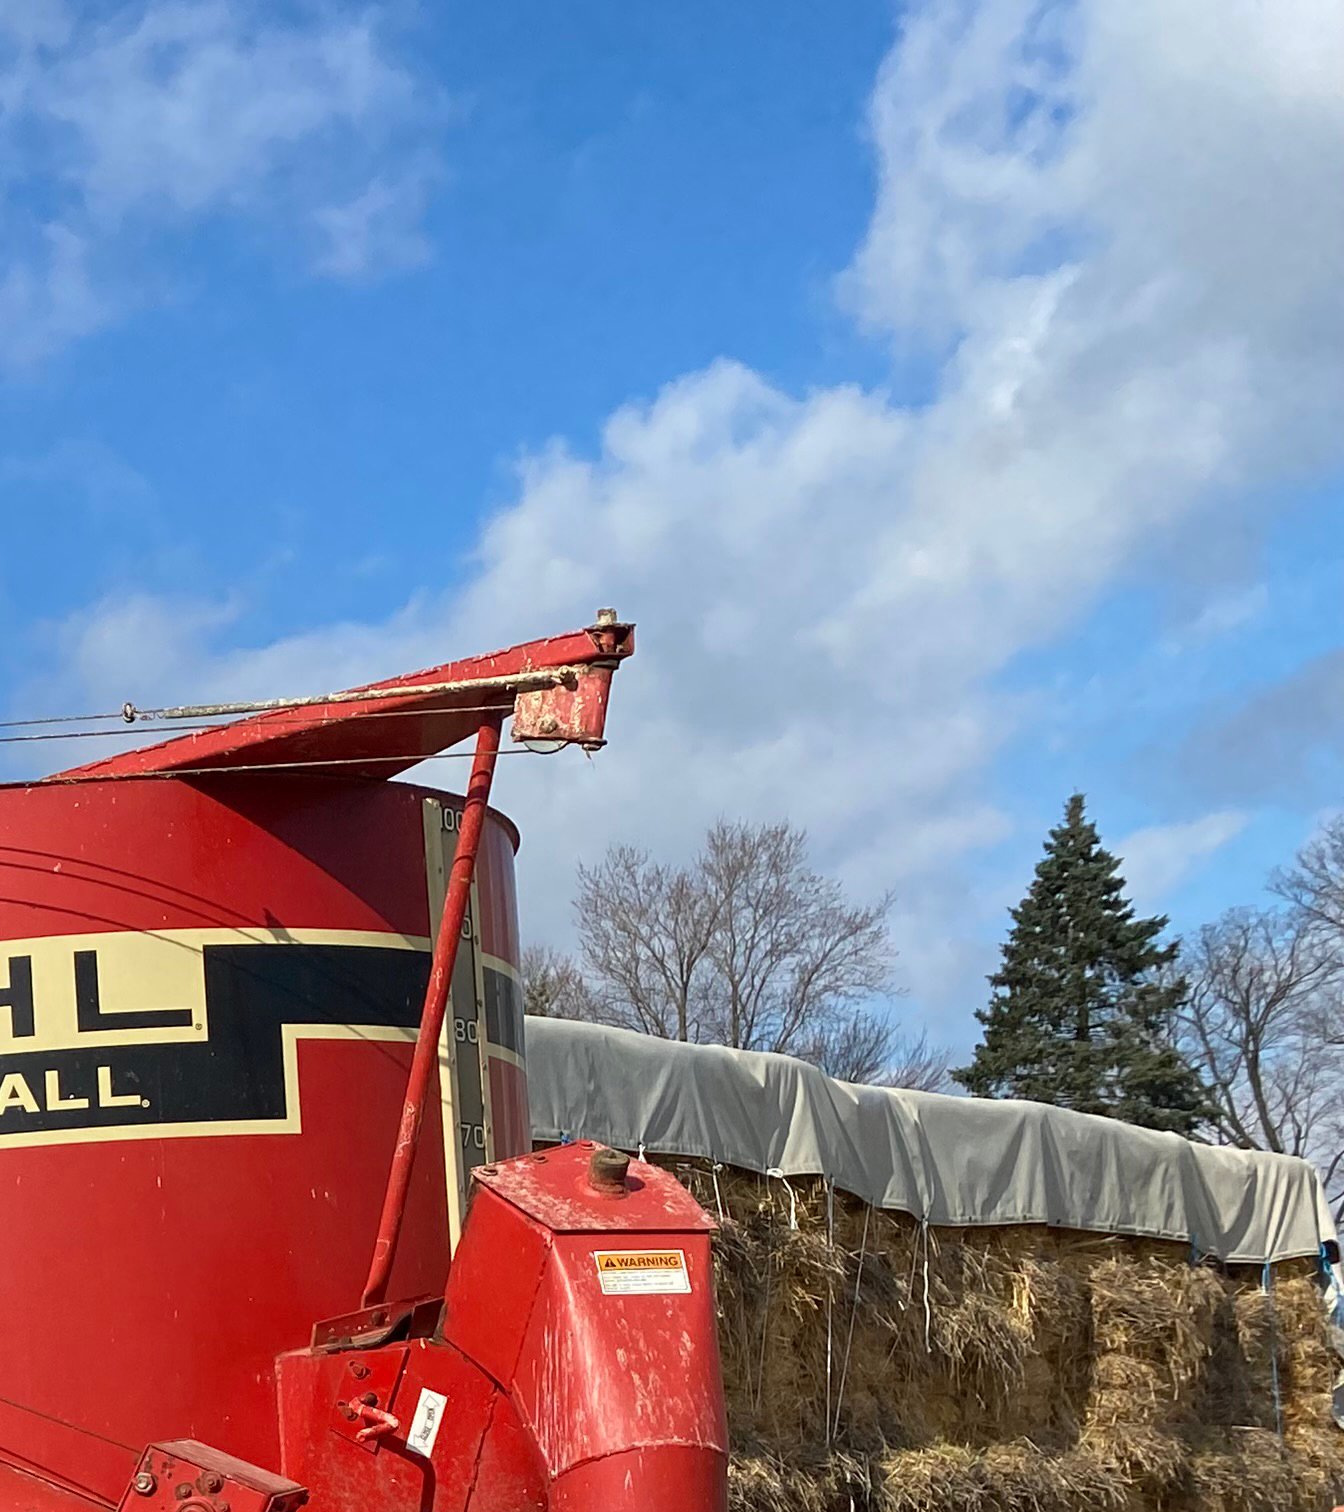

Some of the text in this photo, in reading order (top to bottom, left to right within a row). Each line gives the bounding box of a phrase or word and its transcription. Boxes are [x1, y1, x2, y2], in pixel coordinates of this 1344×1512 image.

[453, 1017, 478, 1045] 80
[461, 1123, 485, 1149] 70
[616, 1256, 678, 1267] WARNING
